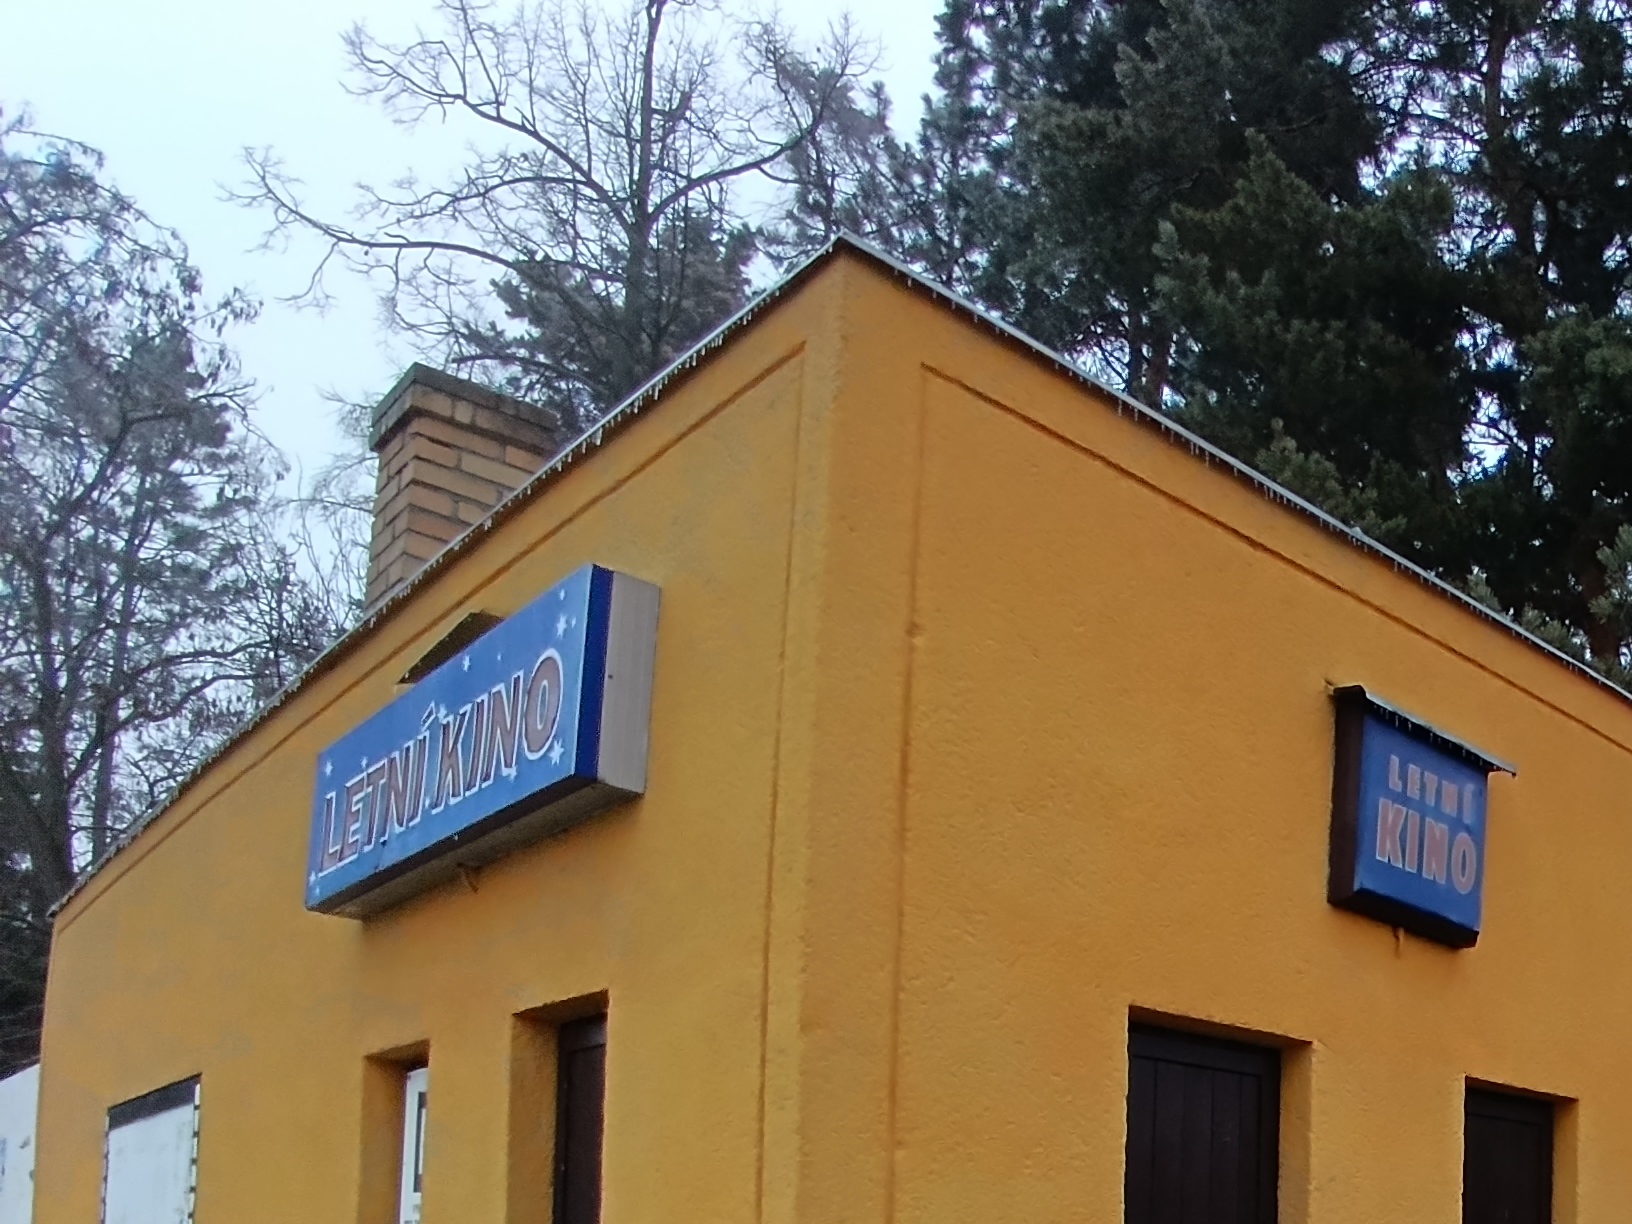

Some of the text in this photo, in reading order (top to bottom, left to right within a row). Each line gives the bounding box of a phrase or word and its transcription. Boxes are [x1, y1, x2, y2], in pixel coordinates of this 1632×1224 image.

[317, 647, 564, 879] LETNÍ KINO
[1388, 754, 1475, 825] LETNÍ
[1375, 797, 1477, 895] KINO
